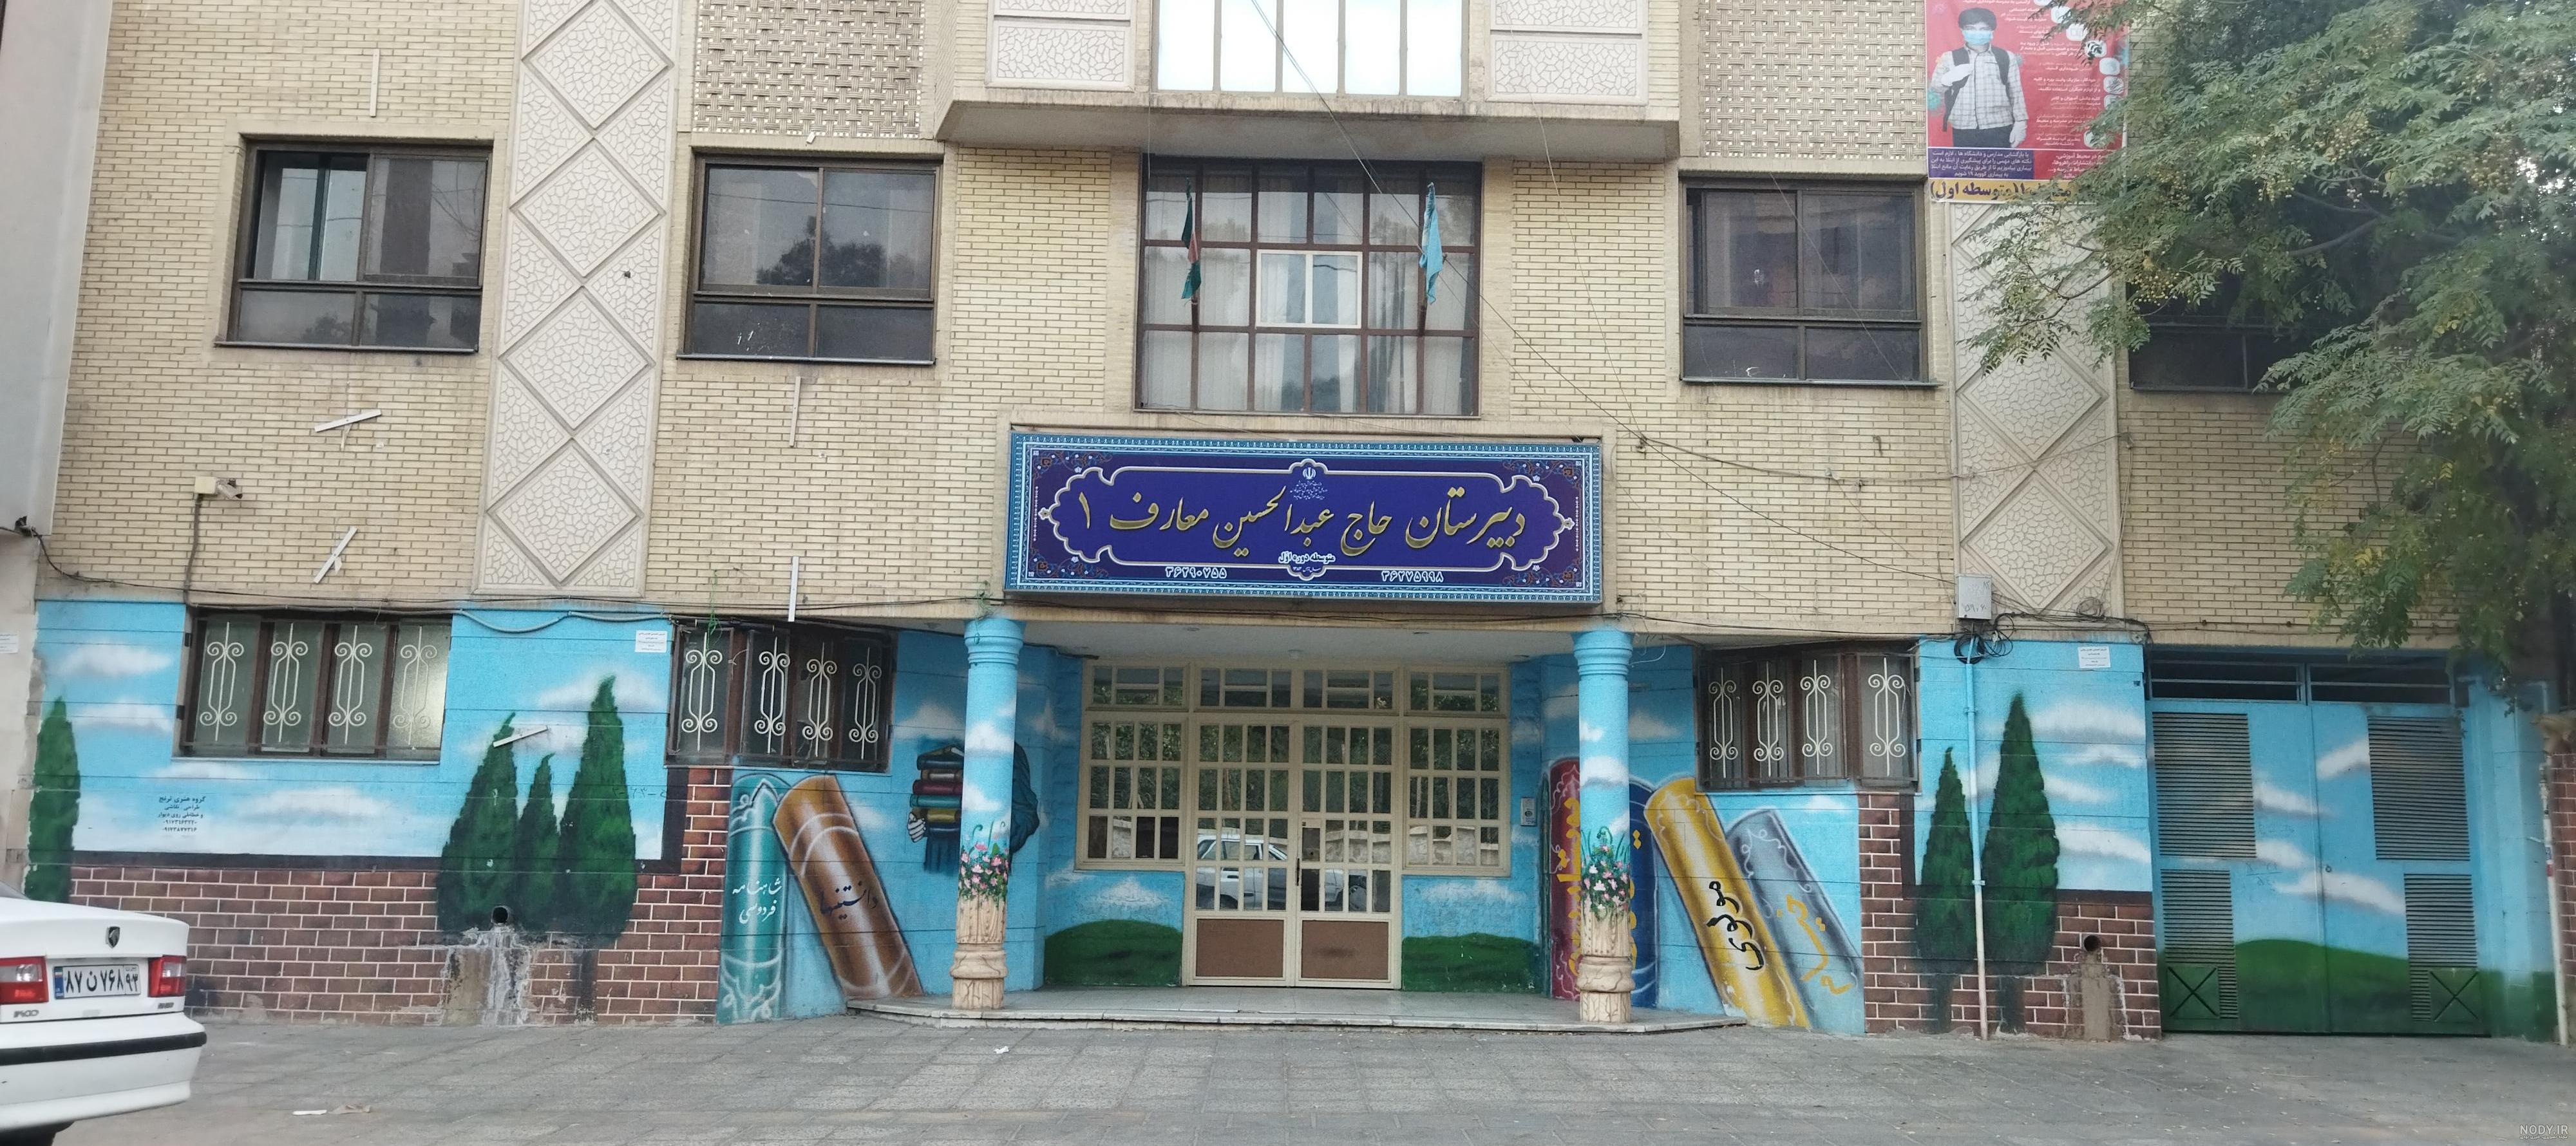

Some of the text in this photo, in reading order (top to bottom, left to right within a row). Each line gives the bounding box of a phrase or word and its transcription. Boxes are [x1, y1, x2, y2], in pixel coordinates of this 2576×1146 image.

[1109, 491, 1209, 531] معارف
[1212, 485, 1335, 558] عبدالحسین
[1405, 486, 1526, 549] دبیرستان
[1340, 500, 1392, 557] حاج
[1292, 553, 1310, 564] دوره
[1309, 552, 1336, 564] متوسطه
[1165, 566, 1227, 579] ۳۶۲۹۰۷۵۵
[1381, 570, 1444, 583] ۳۶۲۷۵۹۹۸
[732, 877, 782, 895] شاهنامه
[739, 899, 778, 924] فردوسی
